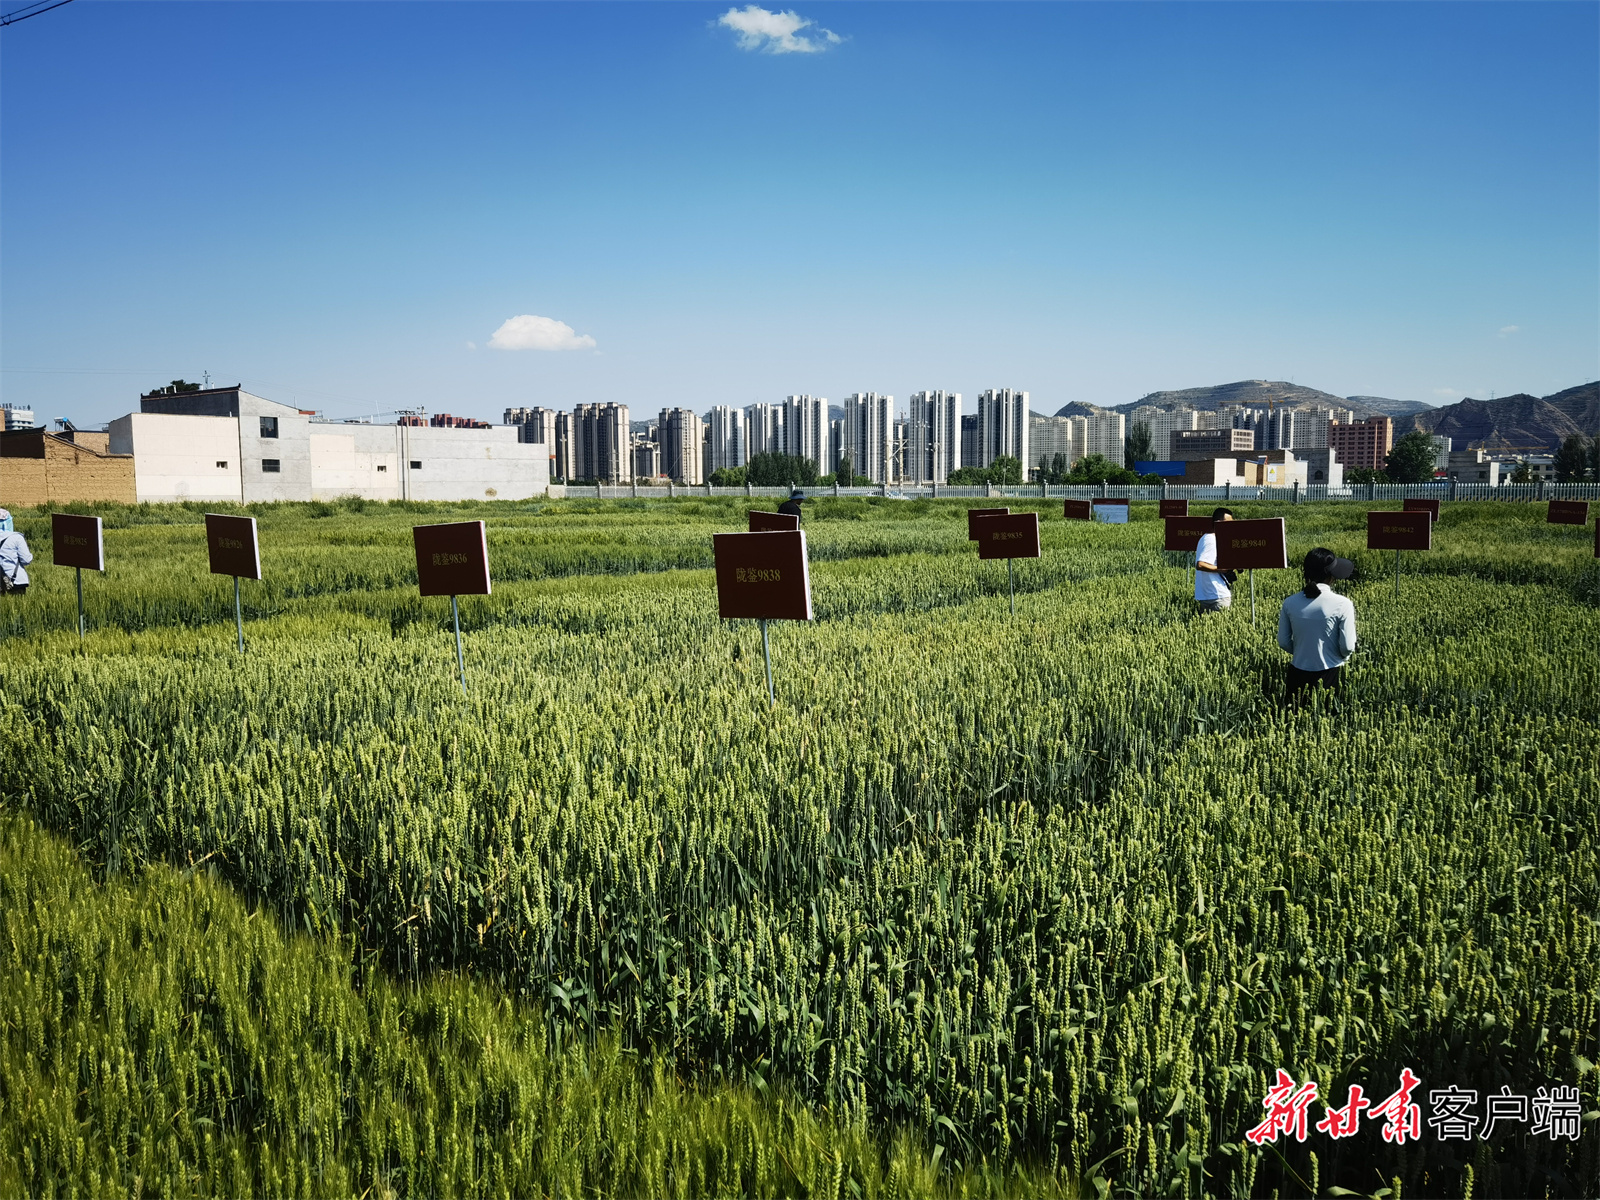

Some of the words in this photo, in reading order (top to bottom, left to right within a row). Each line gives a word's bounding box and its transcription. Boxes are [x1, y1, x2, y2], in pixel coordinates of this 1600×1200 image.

[1231, 538, 1267, 549] 陇鉴9840
[431, 552, 468, 567] 陇鉴9836
[735, 567, 781, 583] 陇鉴9838
